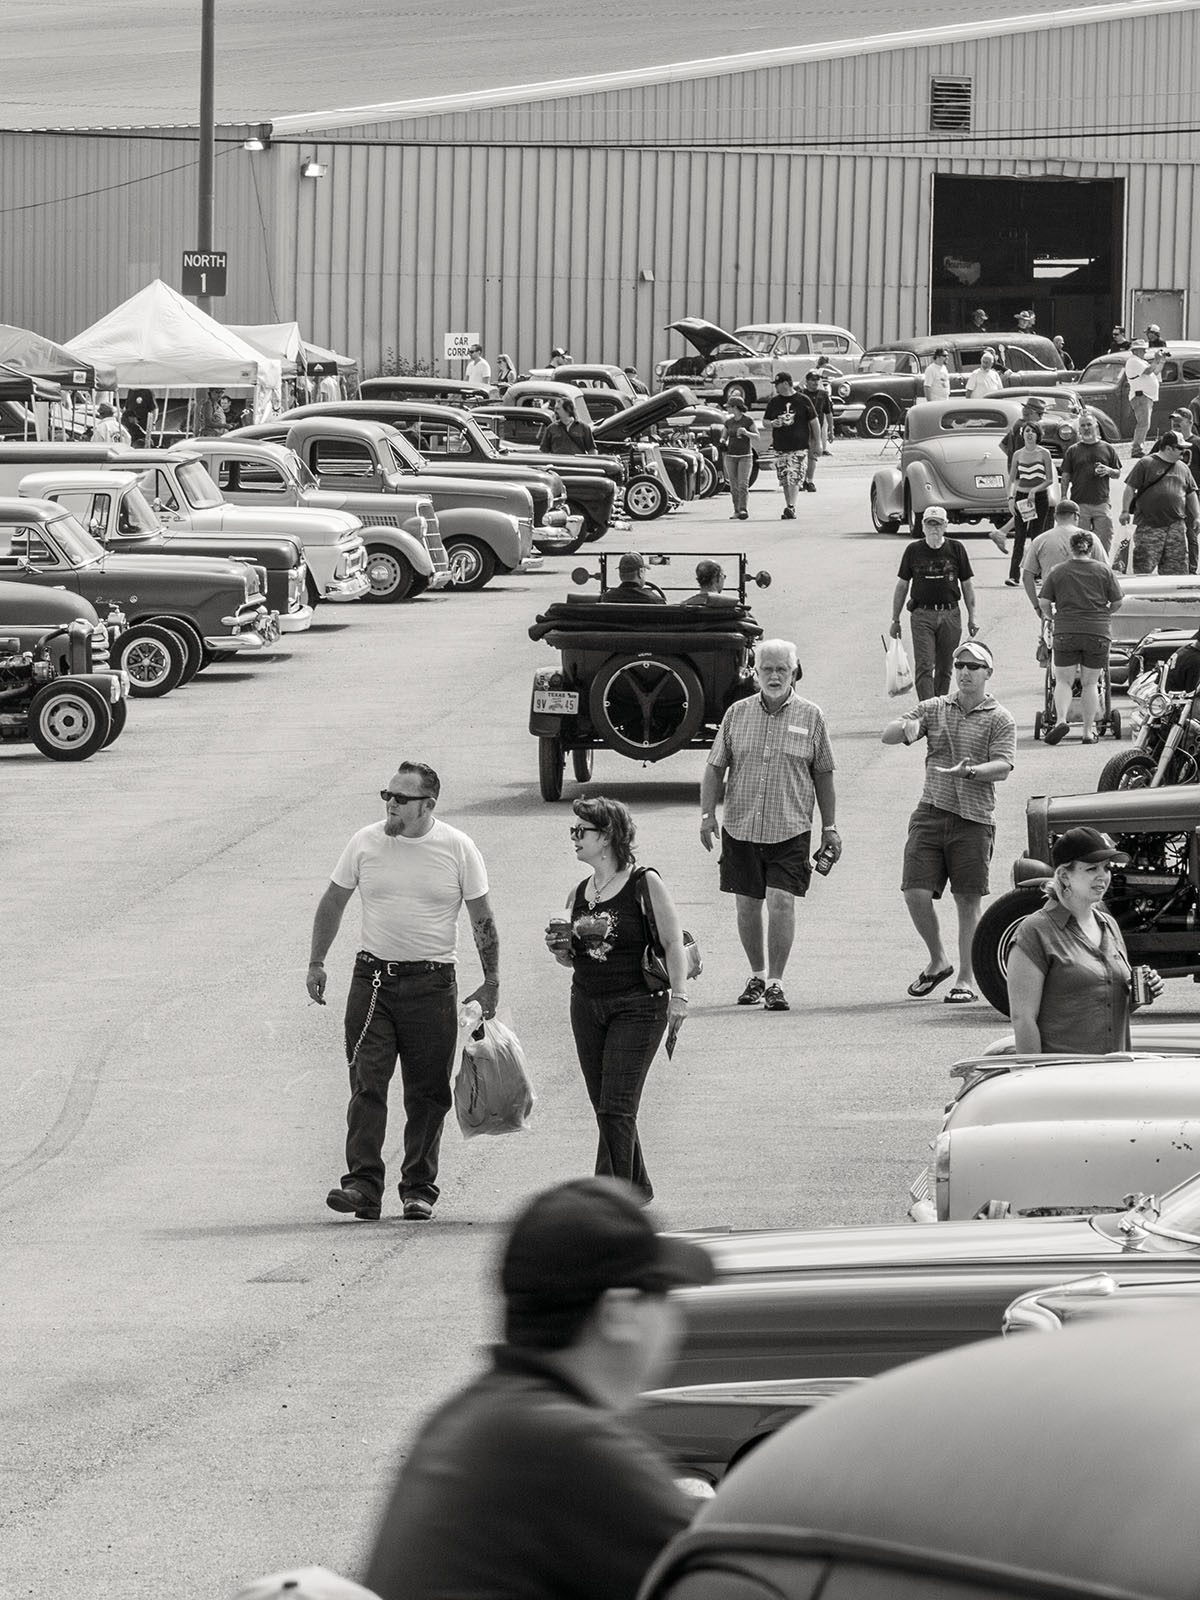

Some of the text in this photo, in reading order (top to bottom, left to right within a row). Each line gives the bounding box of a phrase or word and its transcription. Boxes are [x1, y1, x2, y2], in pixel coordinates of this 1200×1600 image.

[183, 254, 226, 268] NORTH
[200, 272, 207, 293] 1
[454, 336, 469, 346] CAR
[447, 347, 471, 357] CORRA
